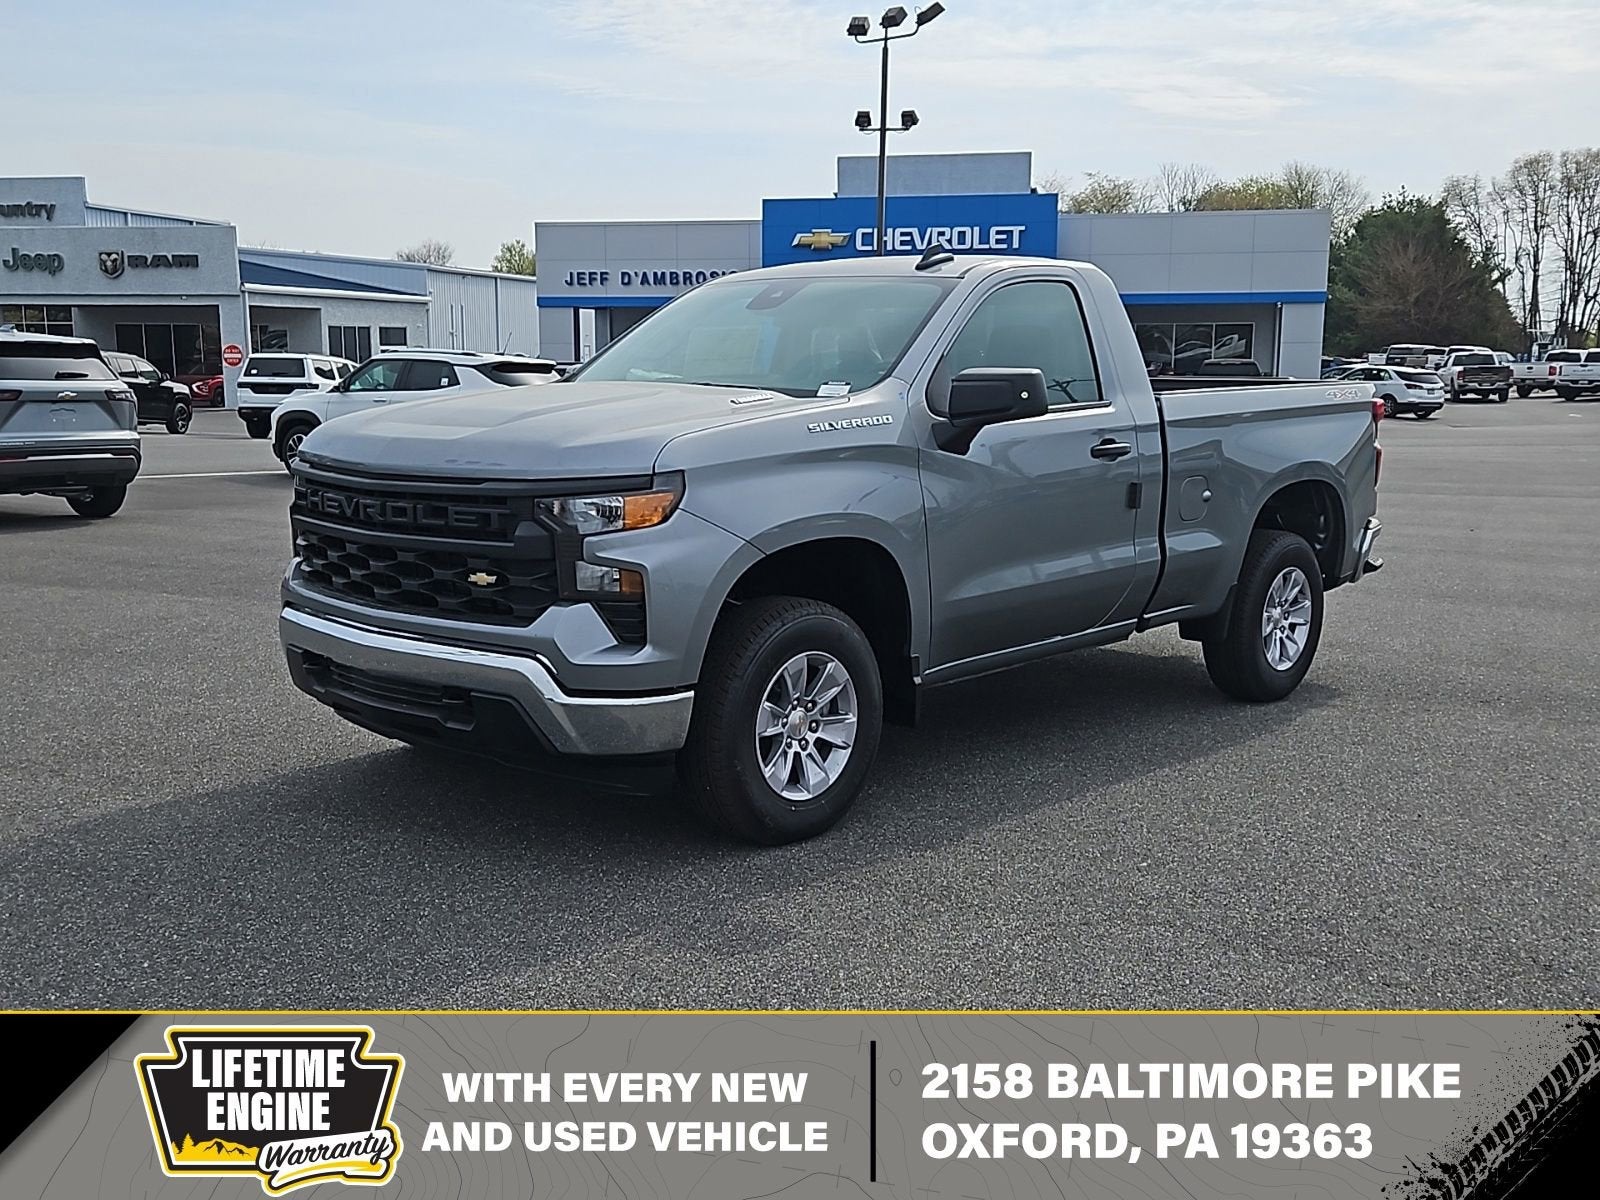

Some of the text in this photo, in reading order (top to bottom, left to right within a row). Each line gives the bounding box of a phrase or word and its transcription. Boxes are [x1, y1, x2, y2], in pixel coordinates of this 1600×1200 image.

[855, 225, 1026, 251] CHEVROLET
[2, 247, 64, 277] Jeep
[127, 253, 199, 269] RAM
[564, 270, 738, 287] JEFF D'AMBRO
[807, 414, 894, 433] SILVERADO
[294, 486, 513, 529] CHEVROLET
